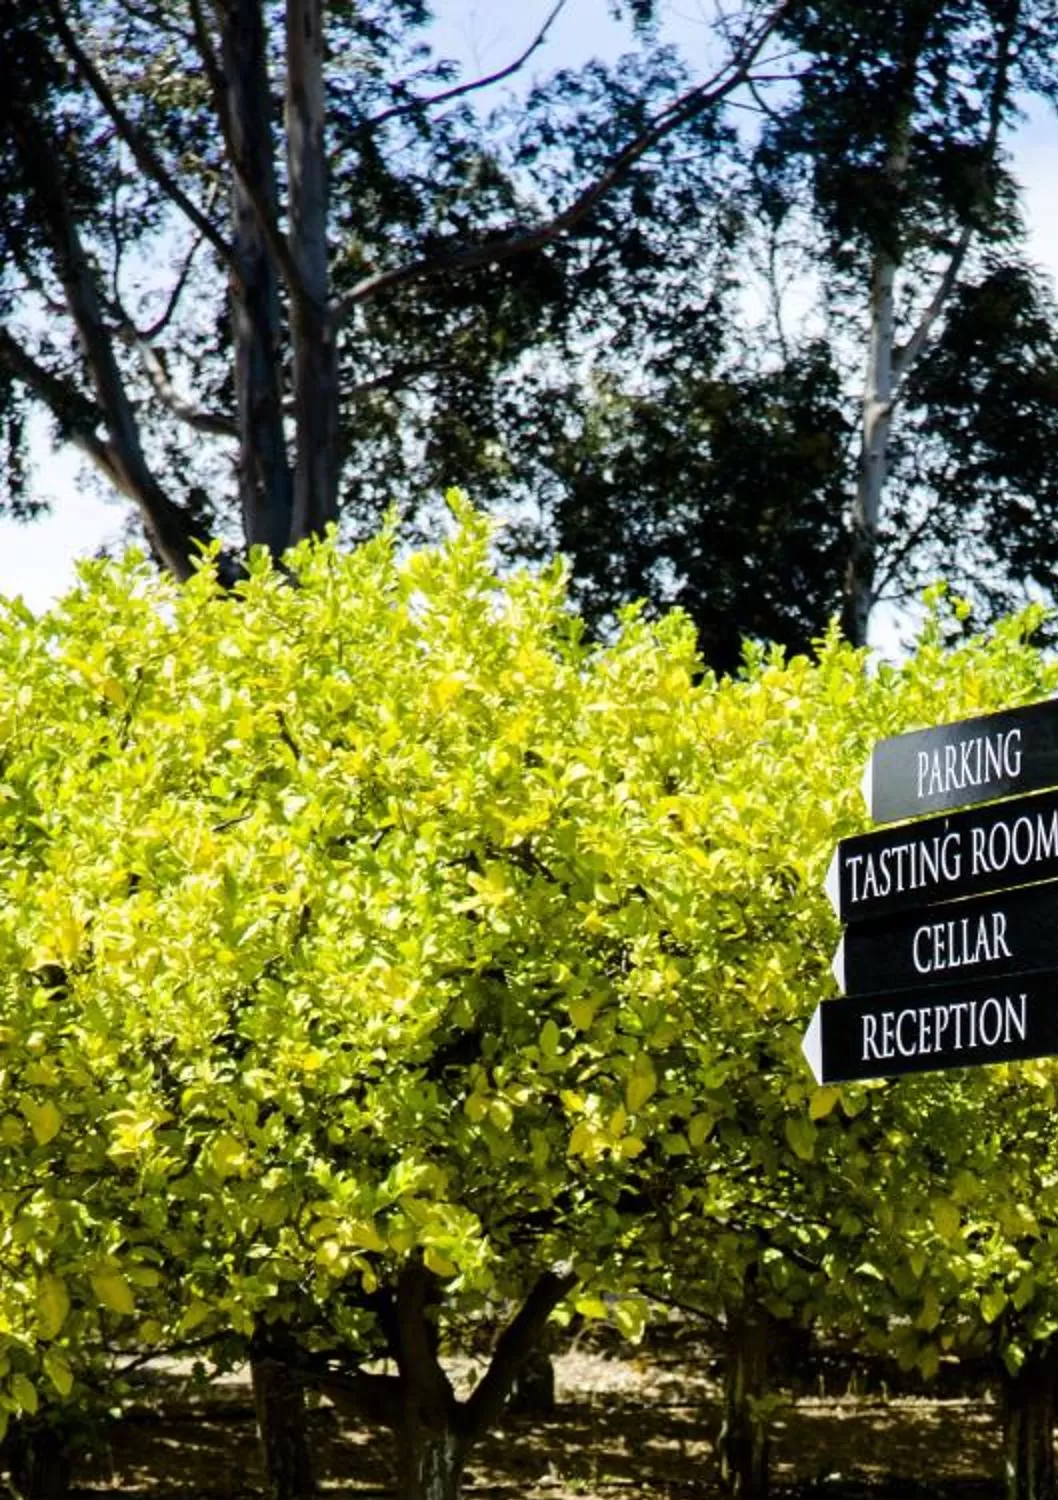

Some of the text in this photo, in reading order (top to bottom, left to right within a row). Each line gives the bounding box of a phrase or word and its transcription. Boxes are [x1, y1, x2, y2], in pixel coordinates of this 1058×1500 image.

[917, 729, 1022, 799] PARKING
[846, 831, 961, 902] TASTING
[913, 911, 1012, 973] CELLAR
[861, 993, 1027, 1061] RECEPTION
